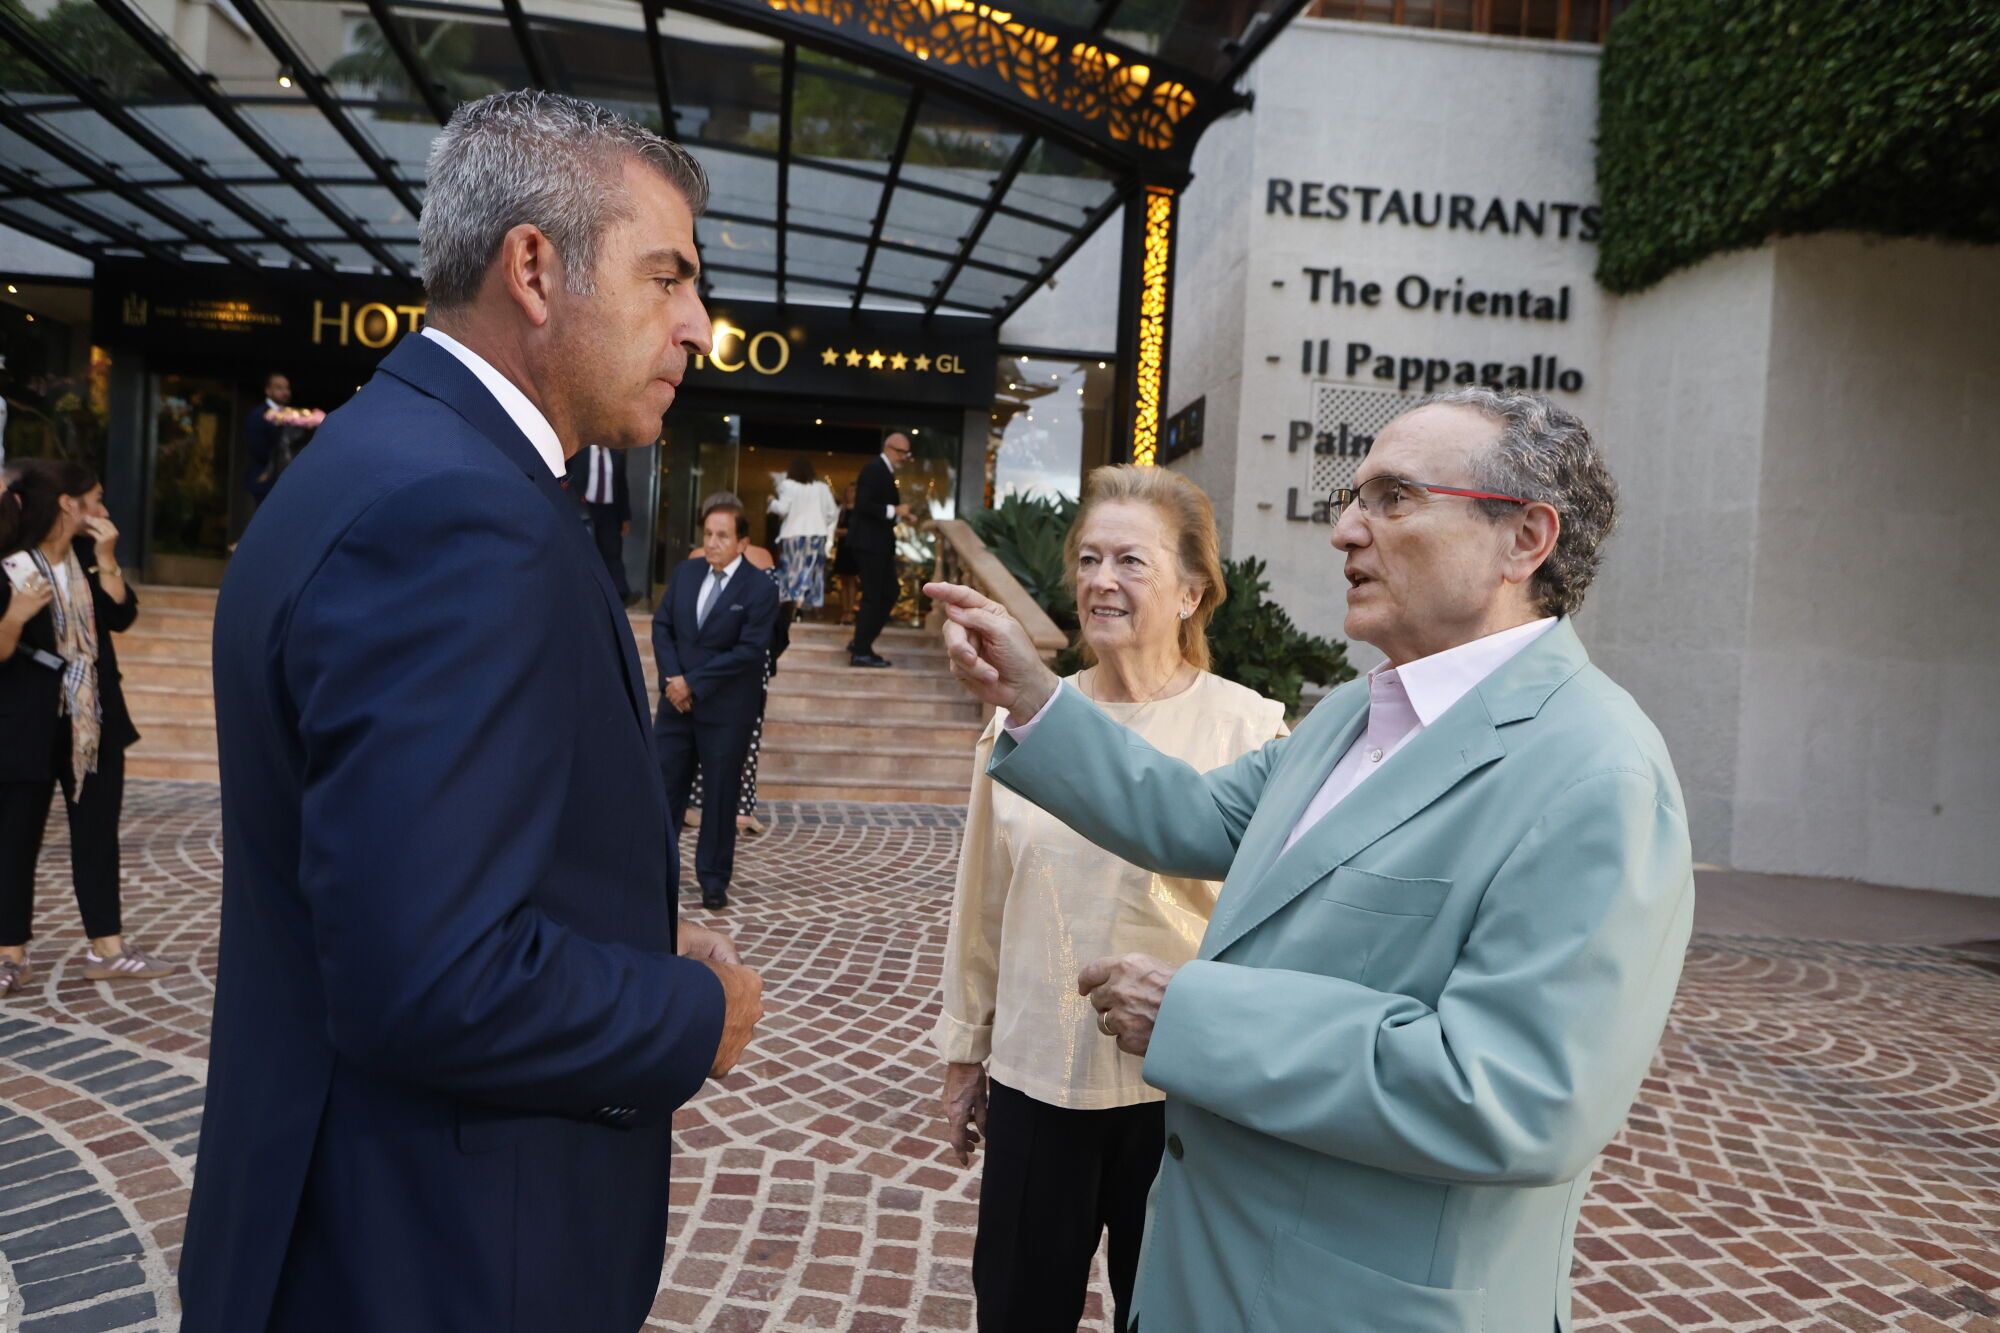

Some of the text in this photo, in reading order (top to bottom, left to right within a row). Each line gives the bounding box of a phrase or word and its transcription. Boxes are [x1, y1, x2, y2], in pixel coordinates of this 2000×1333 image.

[1266, 179, 1601, 242] RESTAURANTS
[1303, 267, 1381, 307] The
[1396, 275, 1570, 321] Oriental
[936, 354, 965, 374] GL
[1302, 339, 1329, 375] Il
[1346, 342, 1584, 393] Pappagallo
